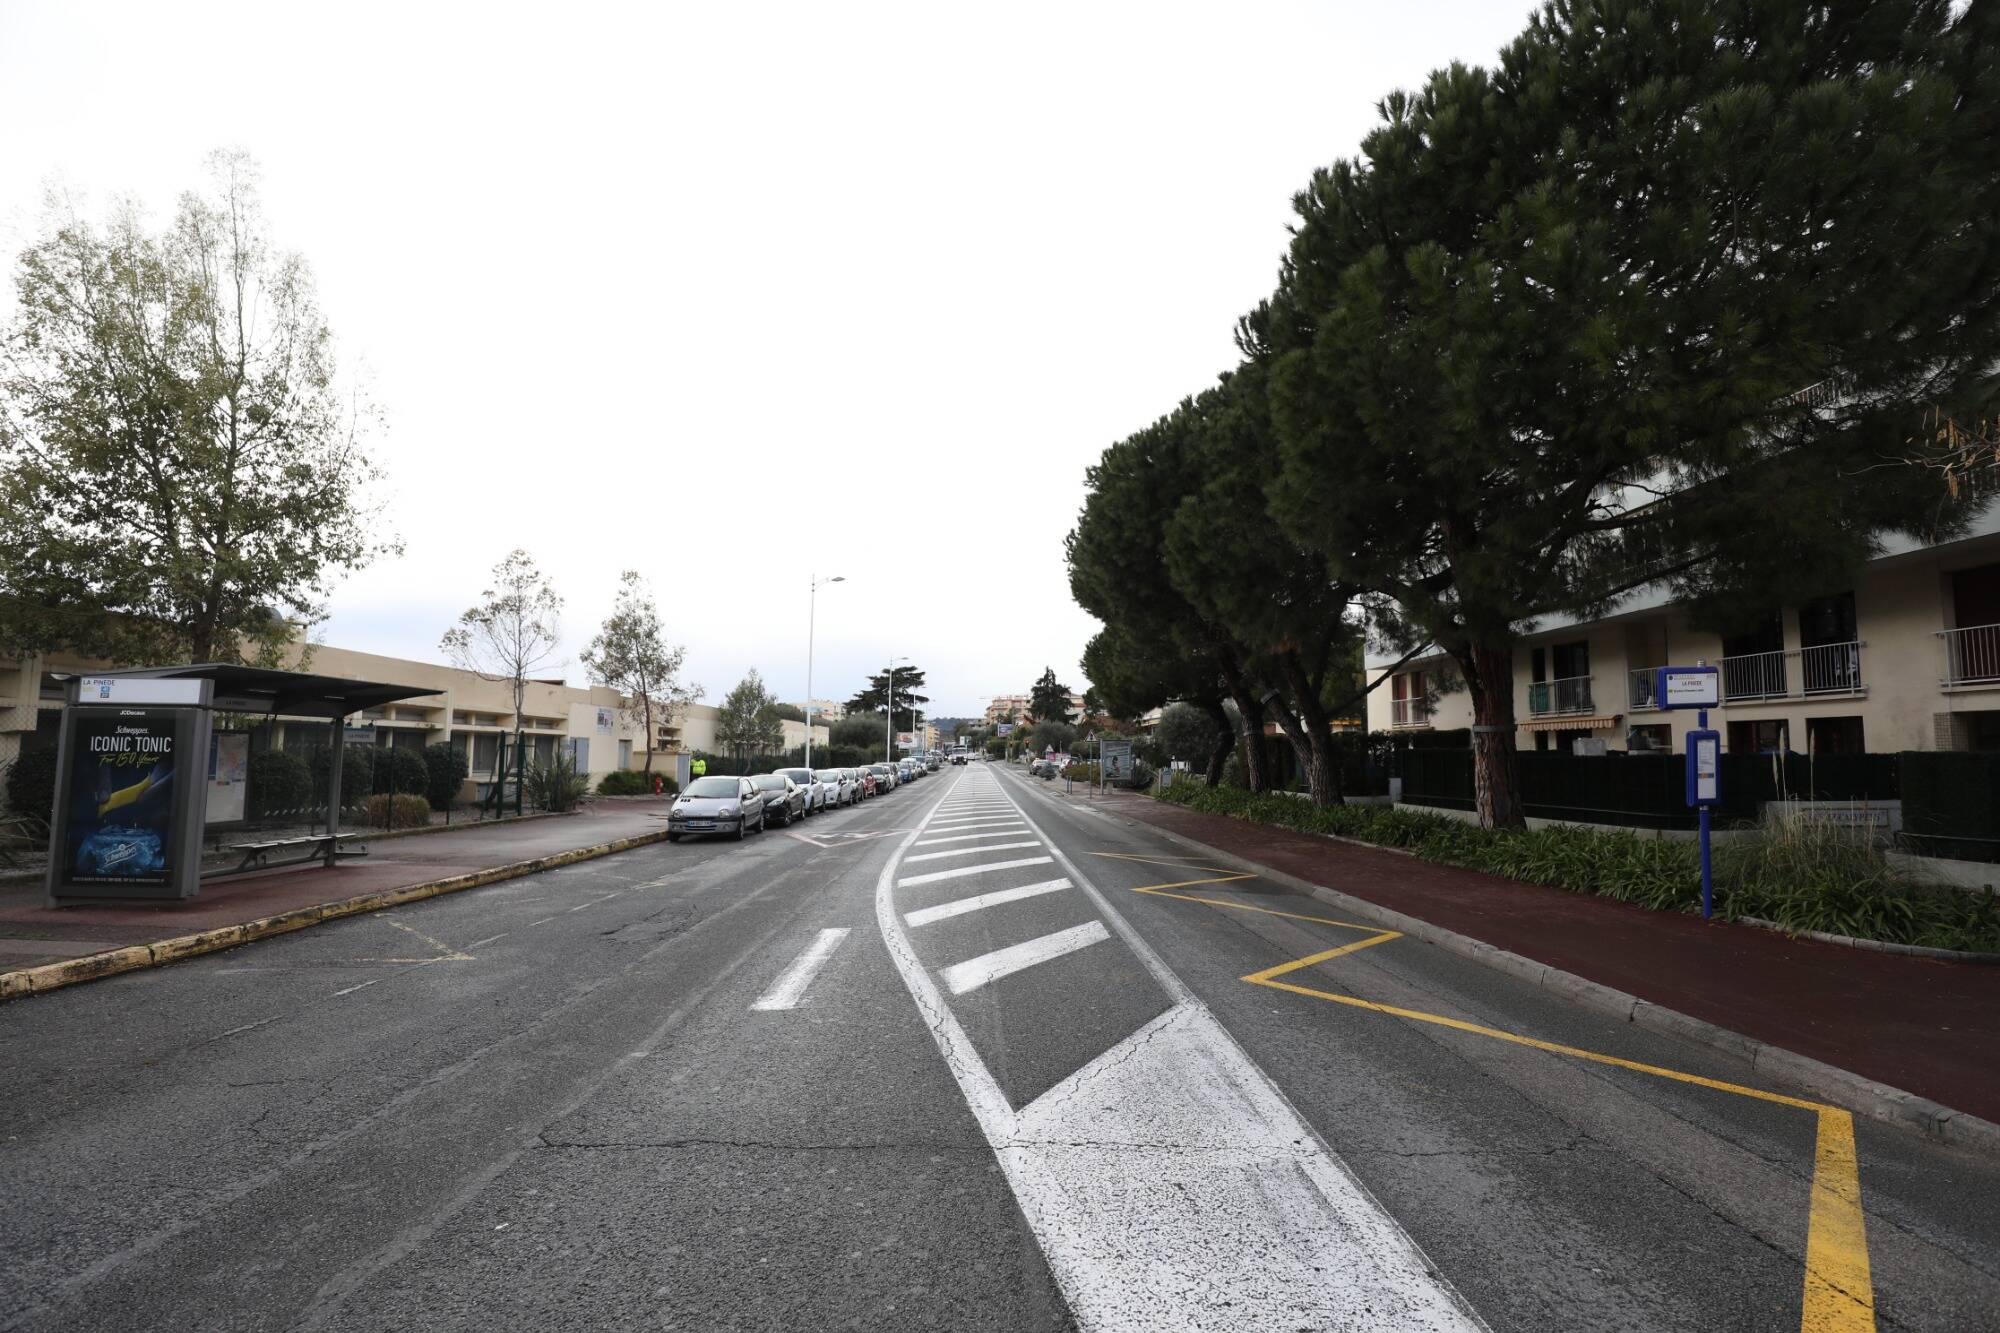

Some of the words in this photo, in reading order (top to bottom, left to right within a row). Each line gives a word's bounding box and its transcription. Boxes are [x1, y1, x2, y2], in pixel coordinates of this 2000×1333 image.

[115, 725, 149, 735] Schweppes
[90, 736, 132, 752] ICONIC
[134, 736, 172, 752] TONIC
[115, 752, 137, 768] 150
